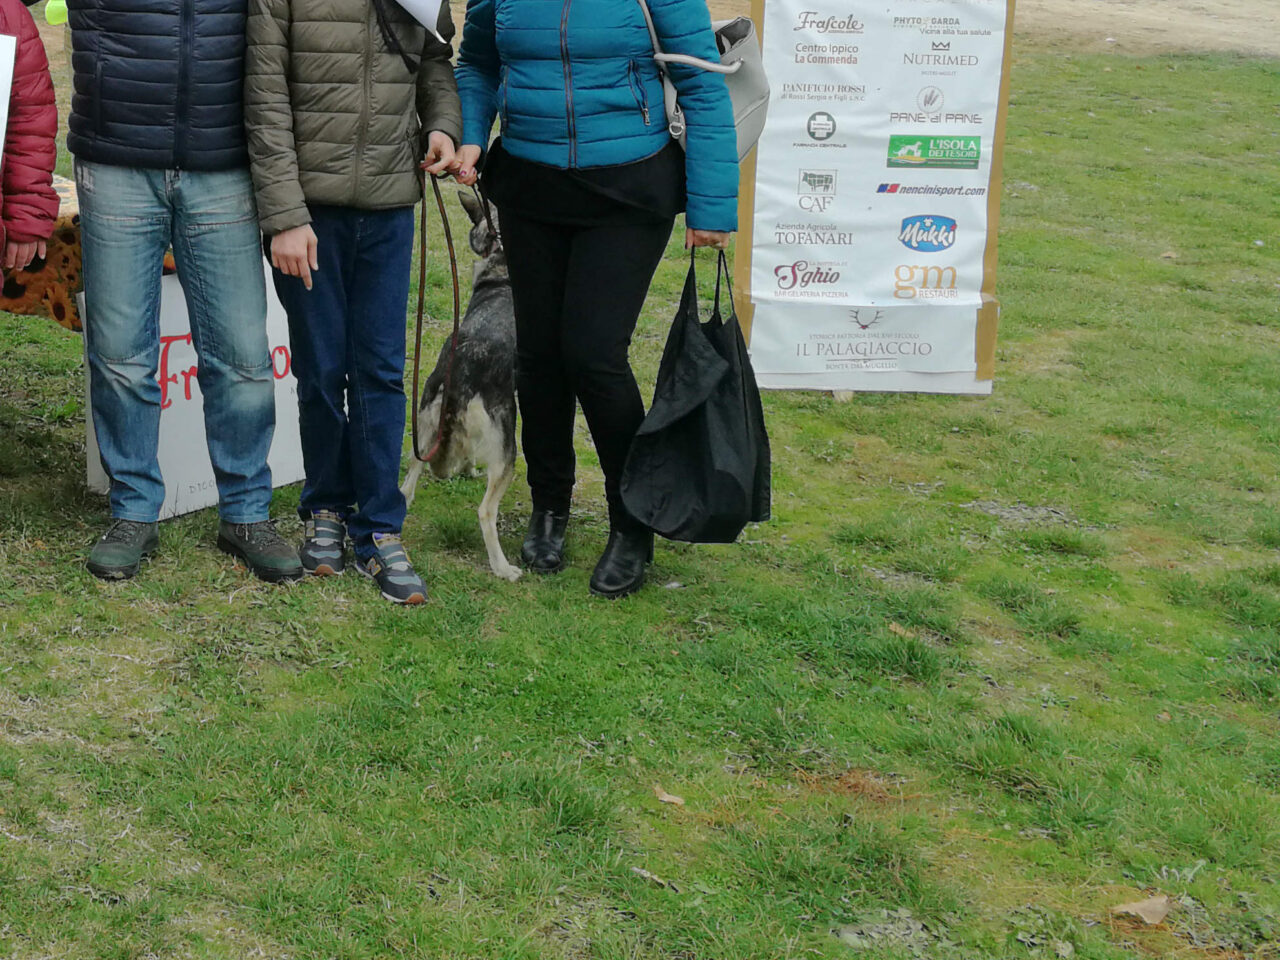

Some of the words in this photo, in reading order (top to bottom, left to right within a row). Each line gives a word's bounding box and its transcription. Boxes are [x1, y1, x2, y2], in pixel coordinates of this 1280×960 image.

[893, 16, 922, 25] PHYTO
[795, 42, 828, 53] Centro
[829, 43, 859, 55] Ippico
[795, 53, 805, 64] La
[807, 53, 858, 65] Commenda
[903, 53, 979, 66] NUTRIMED
[783, 83, 835, 93] PANIFICIO
[837, 84, 866, 94] ROSSI
[890, 112, 926, 123] PANE
[945, 113, 983, 124] PANE
[929, 139, 977, 150] L'ISOLA
[899, 184, 986, 196] nencinisport.com
[799, 195, 833, 213] CAF
[775, 223, 805, 231] Azienda
[806, 223, 837, 232] Agricola
[775, 232, 854, 245] TOFANARI
[898, 221, 957, 248] Mukki
[797, 343, 810, 357] IL
[817, 341, 933, 357] PALAGIACCIO
